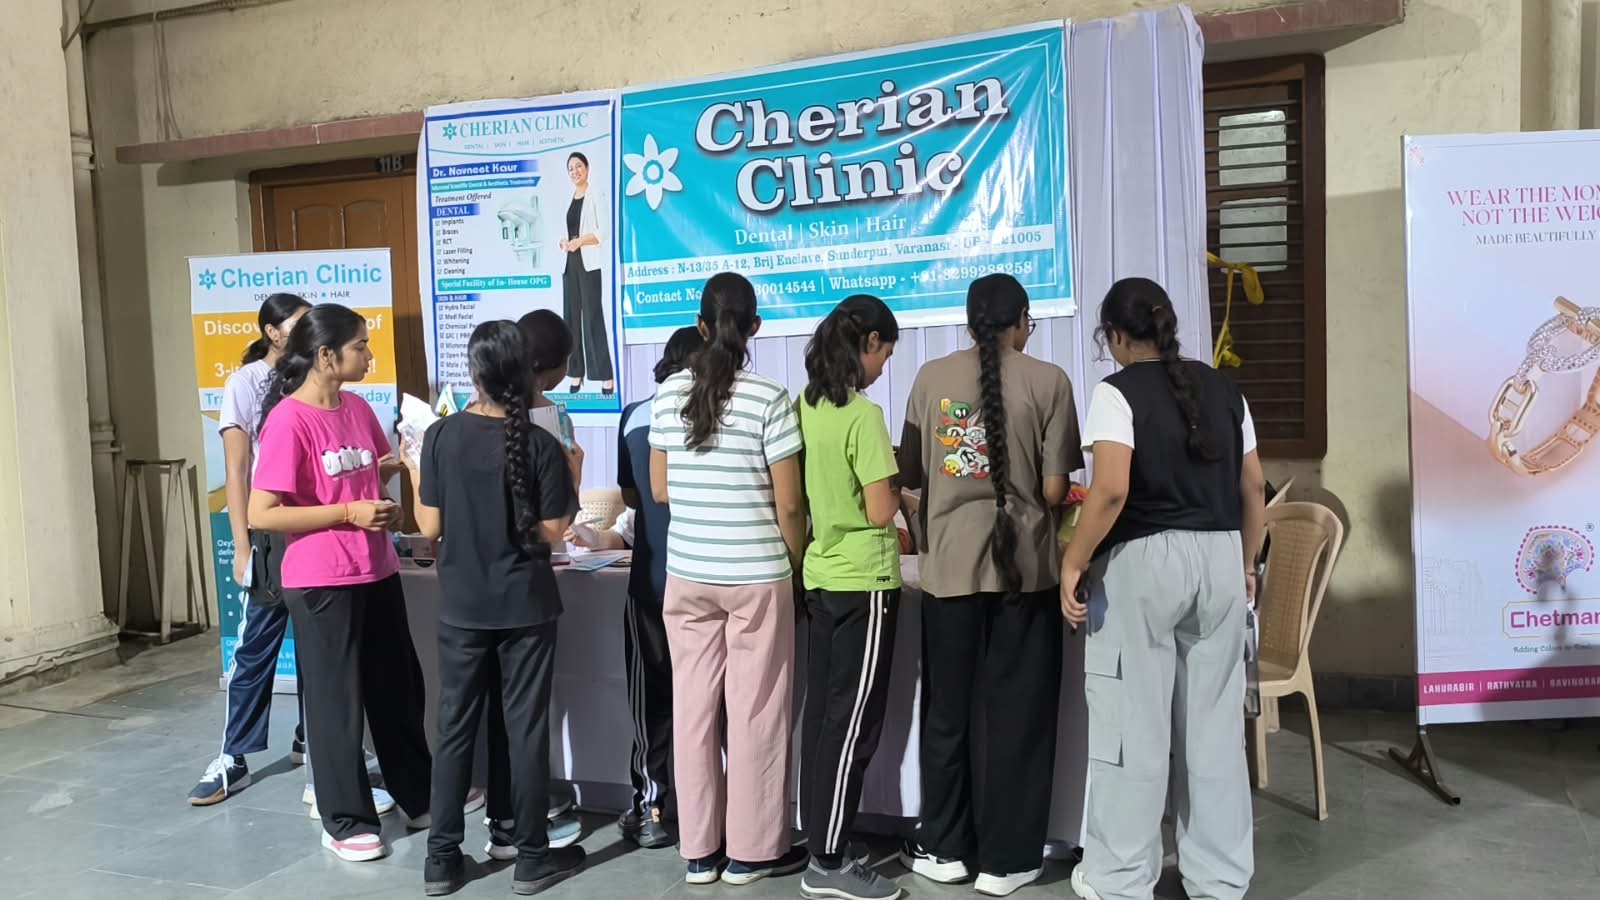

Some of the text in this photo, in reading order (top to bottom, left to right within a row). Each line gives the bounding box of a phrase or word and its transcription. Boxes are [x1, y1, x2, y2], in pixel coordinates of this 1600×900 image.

[694, 76, 1009, 153] Cherian
[460, 112, 589, 138] CHERIAN CLINIC
[432, 168, 447, 178] Dr.
[492, 163, 518, 173] Kaur
[735, 141, 966, 213] Clinic
[435, 191, 492, 203] Treatment Offered
[1446, 188, 1510, 206] WEAR
[1515, 186, 1556, 203] THE
[436, 206, 470, 217] DENTAL
[1461, 208, 1504, 226] NOT
[1508, 206, 1549, 224] THE
[735, 214, 907, 246] Dental Skin Hair
[1475, 229, 1596, 246] MADE BEAUTIFULLY
[443, 258, 469, 266] Whitening
[627, 265, 669, 279] Address
[677, 261, 719, 275] N-13/35
[722, 258, 750, 271] A-12,
[753, 255, 774, 270] Brij
[895, 240, 950, 256] Varanasi
[997, 230, 1042, 248] 21005
[220, 263, 383, 289] Cherian Clinic
[443, 267, 465, 276] Cleaning
[441, 279, 462, 289] Special
[462, 278, 486, 289] Facility
[488, 278, 495, 287] of
[508, 278, 528, 286] House
[529, 277, 548, 285] OPG
[636, 289, 682, 306] Contact
[828, 274, 897, 291] Whatsapp
[330, 290, 351, 299] HAIR
[460, 303, 475, 311] Facial
[203, 313, 383, 336] Discov of
[1423, 682, 1474, 694] LAHURABIR
[1487, 679, 1537, 691] RATHYATRA
